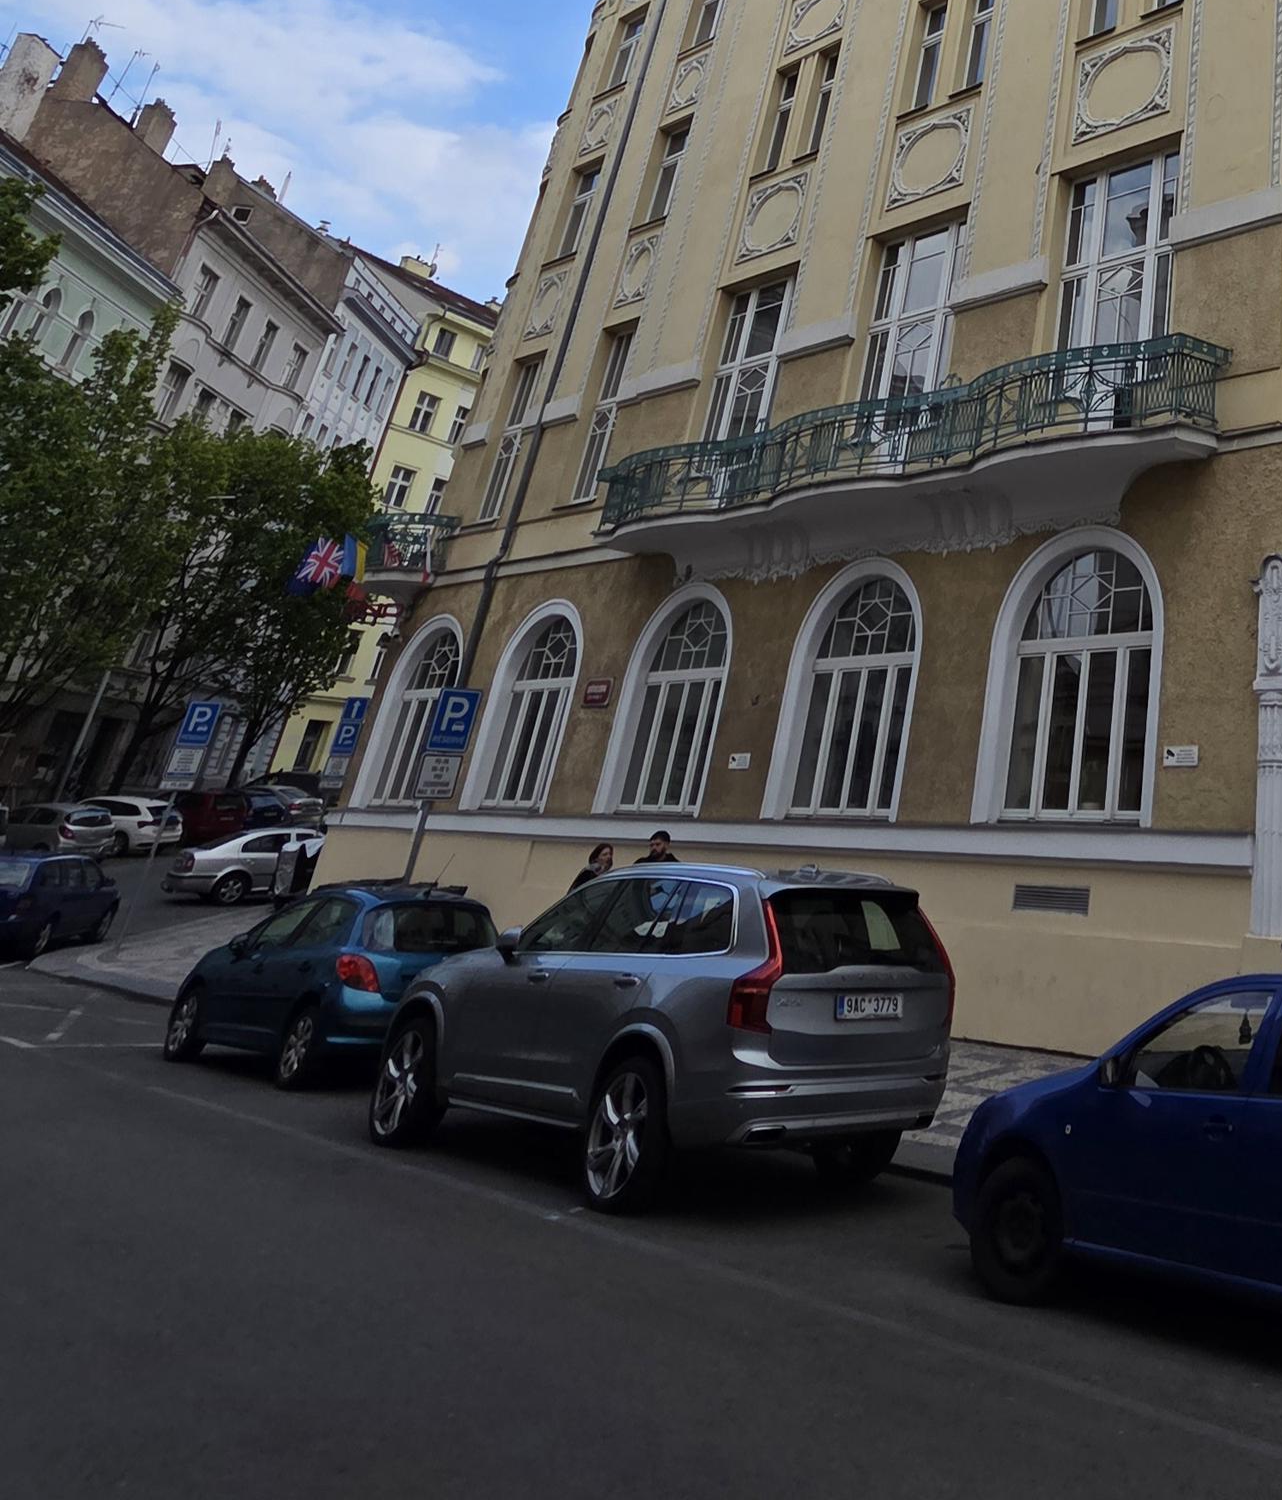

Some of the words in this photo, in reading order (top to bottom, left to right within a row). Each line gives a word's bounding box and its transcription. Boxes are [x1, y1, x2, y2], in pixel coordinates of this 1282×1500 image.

[188, 706, 213, 732] P
[440, 696, 470, 732] P
[338, 726, 355, 745] P
[846, 998, 866, 1014] 9AC
[873, 997, 899, 1013] 3779
